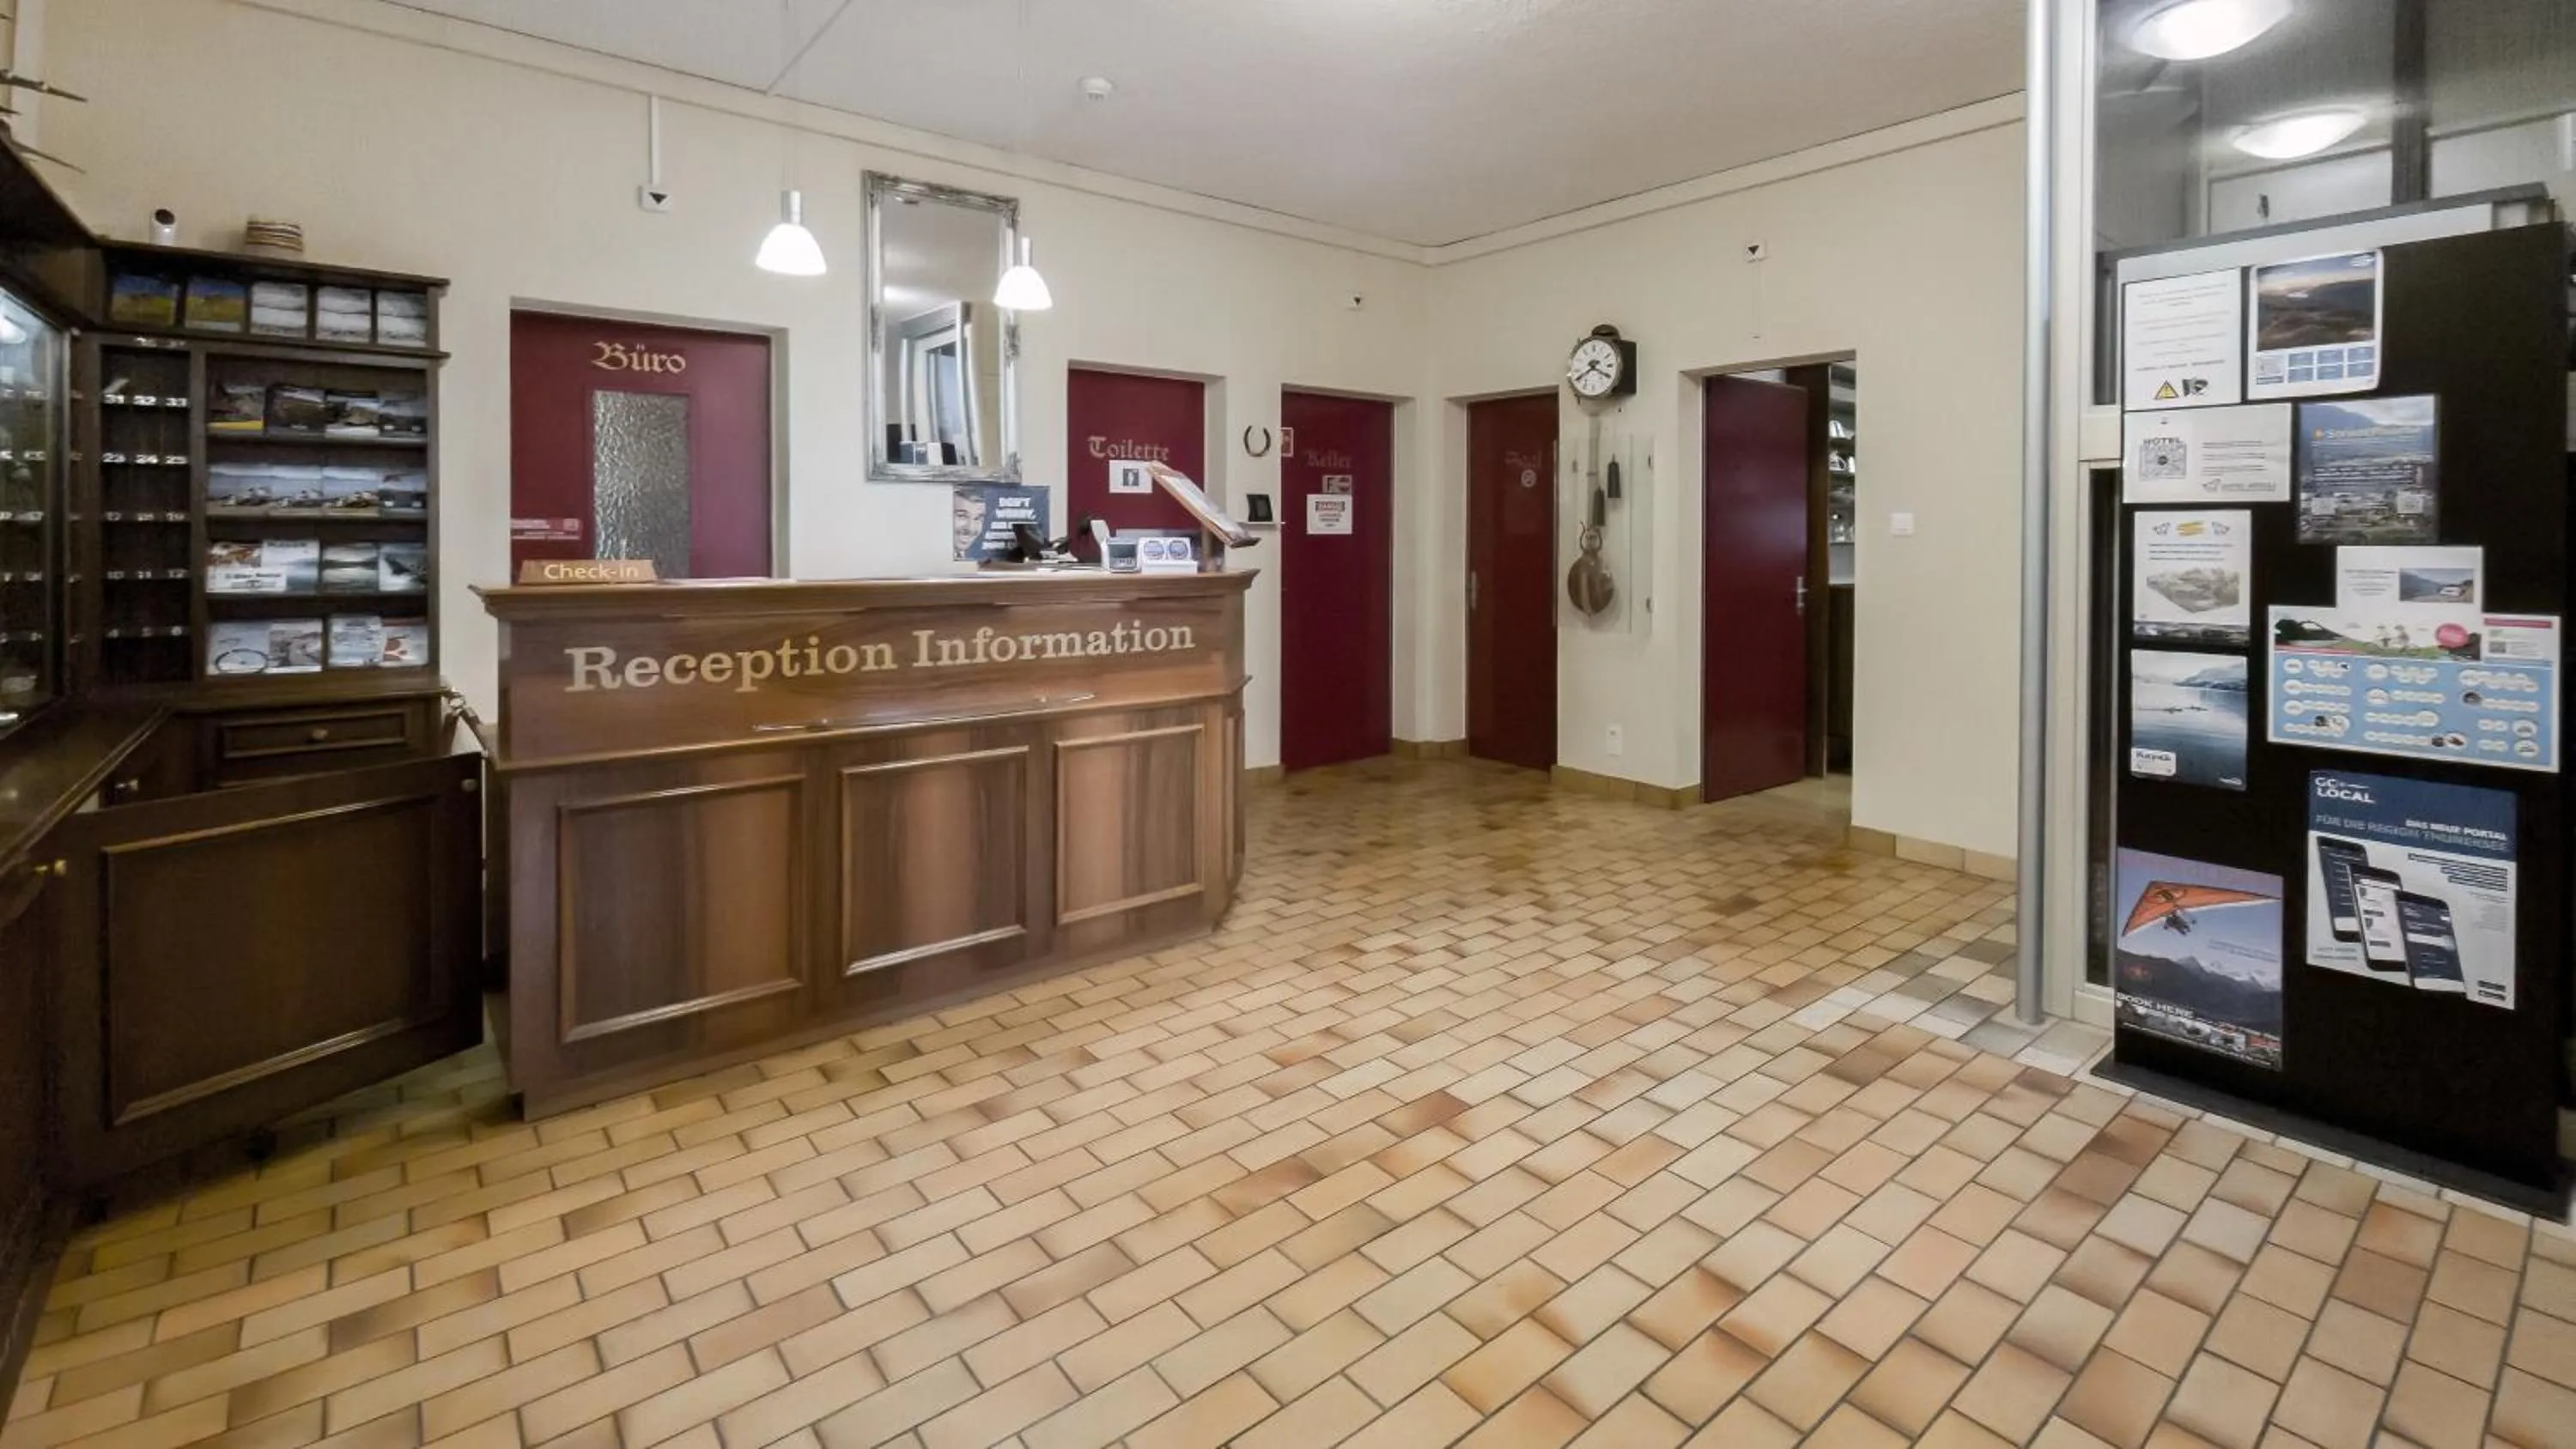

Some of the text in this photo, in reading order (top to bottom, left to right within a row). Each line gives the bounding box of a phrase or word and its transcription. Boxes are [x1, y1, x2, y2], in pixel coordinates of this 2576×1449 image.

[590, 341, 686, 373] Büro
[1087, 435, 1170, 461] Toilette
[543, 563, 640, 579] Check-in
[565, 619, 1196, 693] Reception Information
[2317, 788, 2376, 804] LOCAL
[2463, 827, 2507, 840] PORTAL
[2117, 991, 2195, 1019] BOOK HERE
